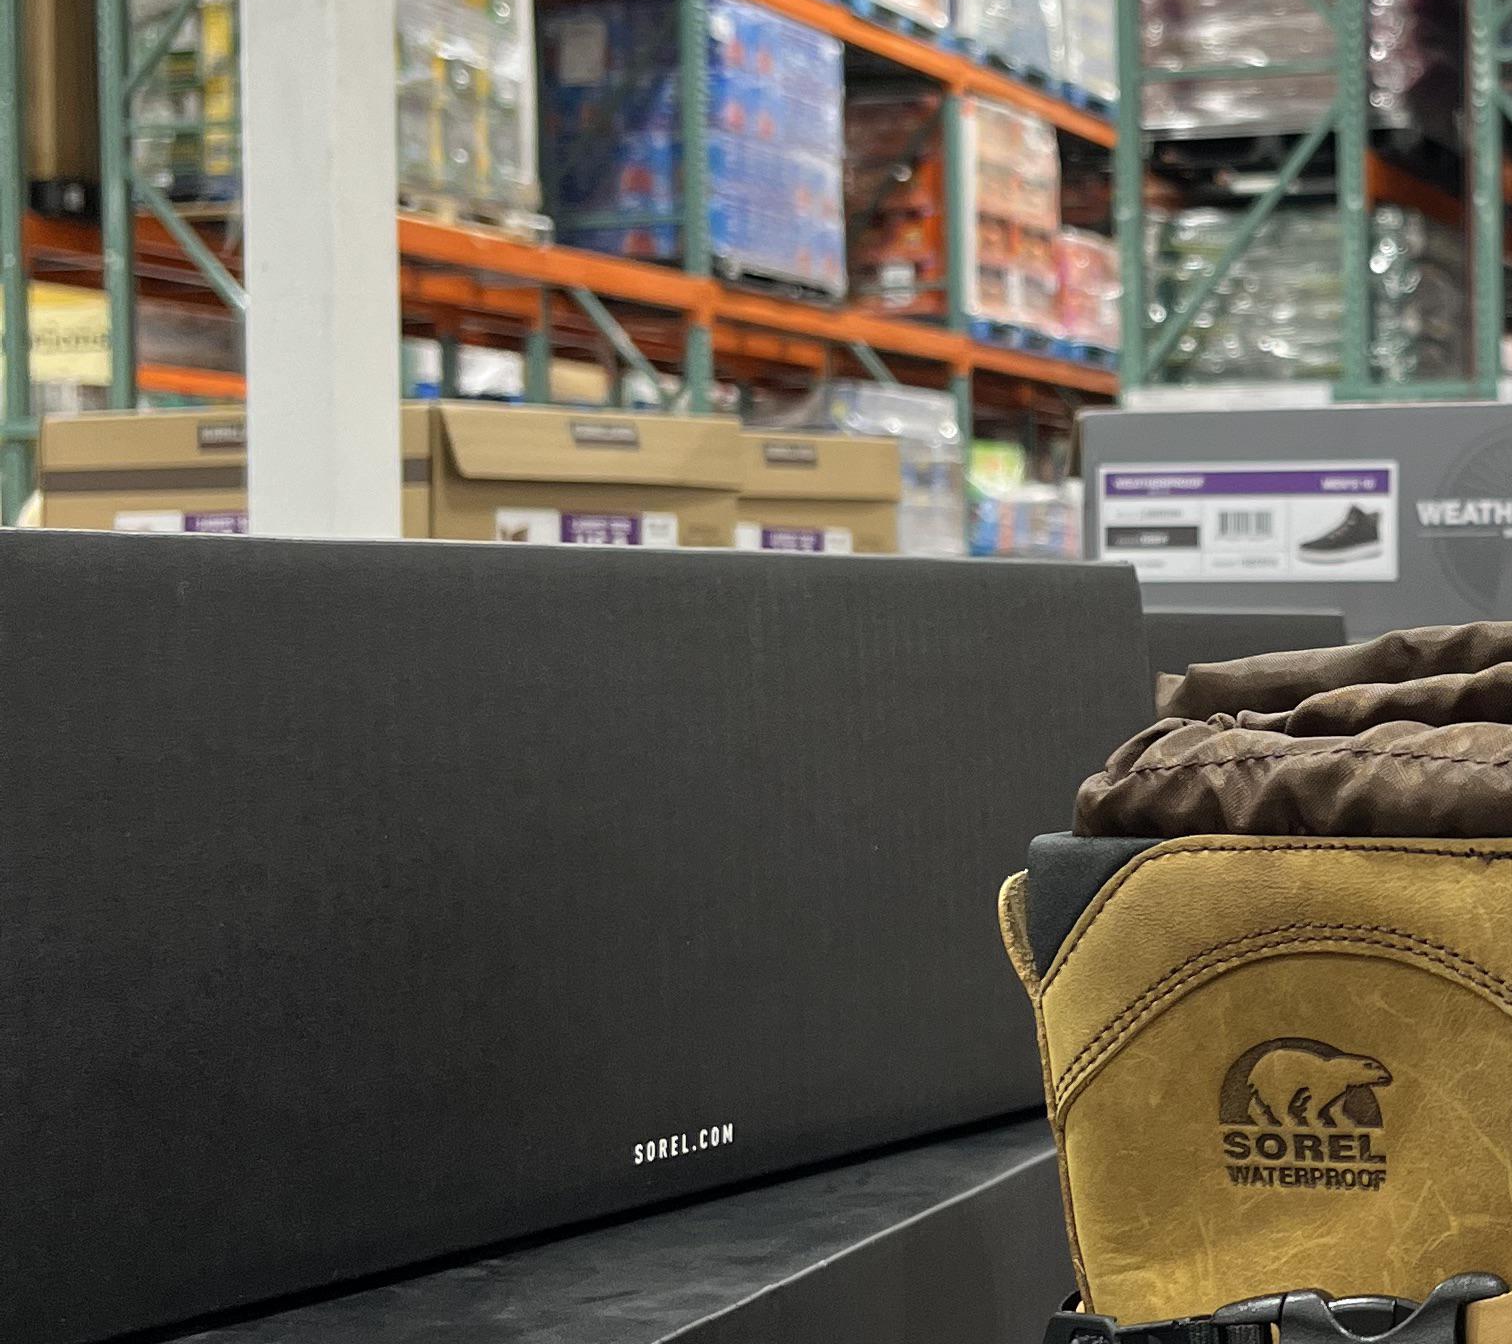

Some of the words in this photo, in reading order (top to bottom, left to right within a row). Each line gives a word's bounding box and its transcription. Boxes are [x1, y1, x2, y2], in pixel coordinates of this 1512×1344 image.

[634, 1122, 734, 1165] SOREL.COM
[1223, 1131, 1387, 1163] SOREL
[1224, 1165, 1387, 1191] WATERPROOF
